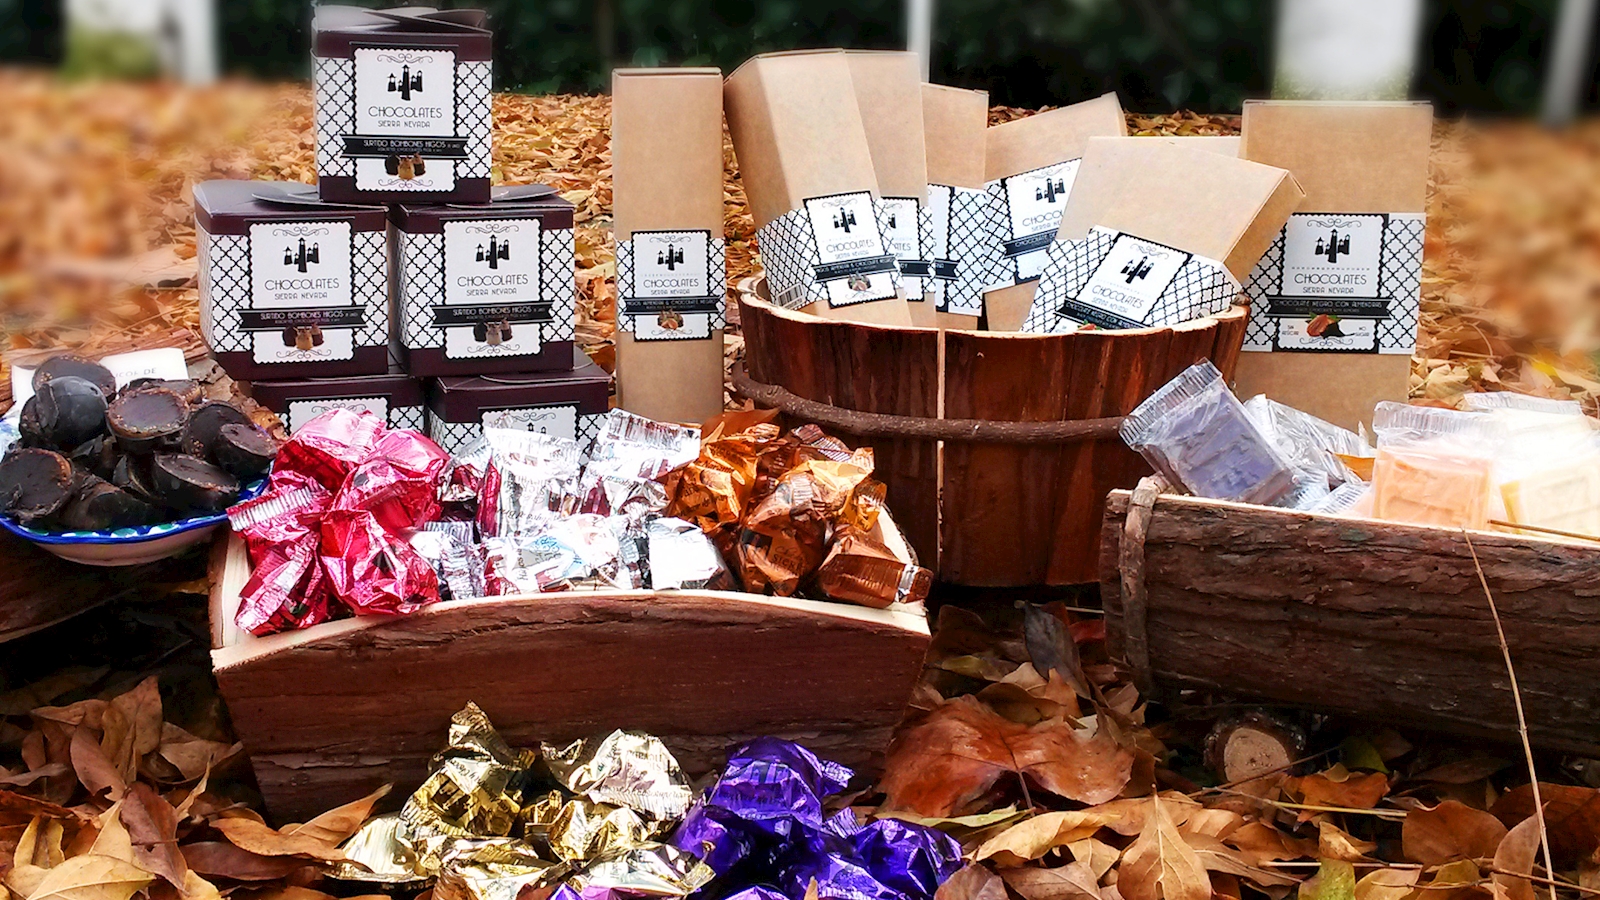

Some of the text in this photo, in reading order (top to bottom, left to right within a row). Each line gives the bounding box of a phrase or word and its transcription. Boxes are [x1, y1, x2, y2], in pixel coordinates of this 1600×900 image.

[368, 106, 442, 118] CHOCOLATES
[377, 120, 430, 128] SIERRA NEVADA
[363, 140, 388, 148] SURTIDO
[390, 140, 424, 148] BOMBONES
[425, 140, 446, 148] HIGOS
[826, 239, 875, 253] CHOCOLATES
[264, 278, 340, 290] CHOCOLATES
[457, 274, 528, 287] CHOCOLATES
[643, 278, 699, 288] CHOCOLATES
[1294, 273, 1367, 285] CHOCOLATES
[274, 291, 328, 300] SIERRA NEVADA
[1092, 285, 1145, 309] CHOCOLATES
[287, 311, 321, 319] BOMBONES
[322, 310, 344, 318] HIGOS
[452, 309, 476, 317] SURTIDO
[478, 307, 511, 315] BOMBONES
[512, 306, 531, 314] HIGOS
[143, 367, 157, 376] DE
